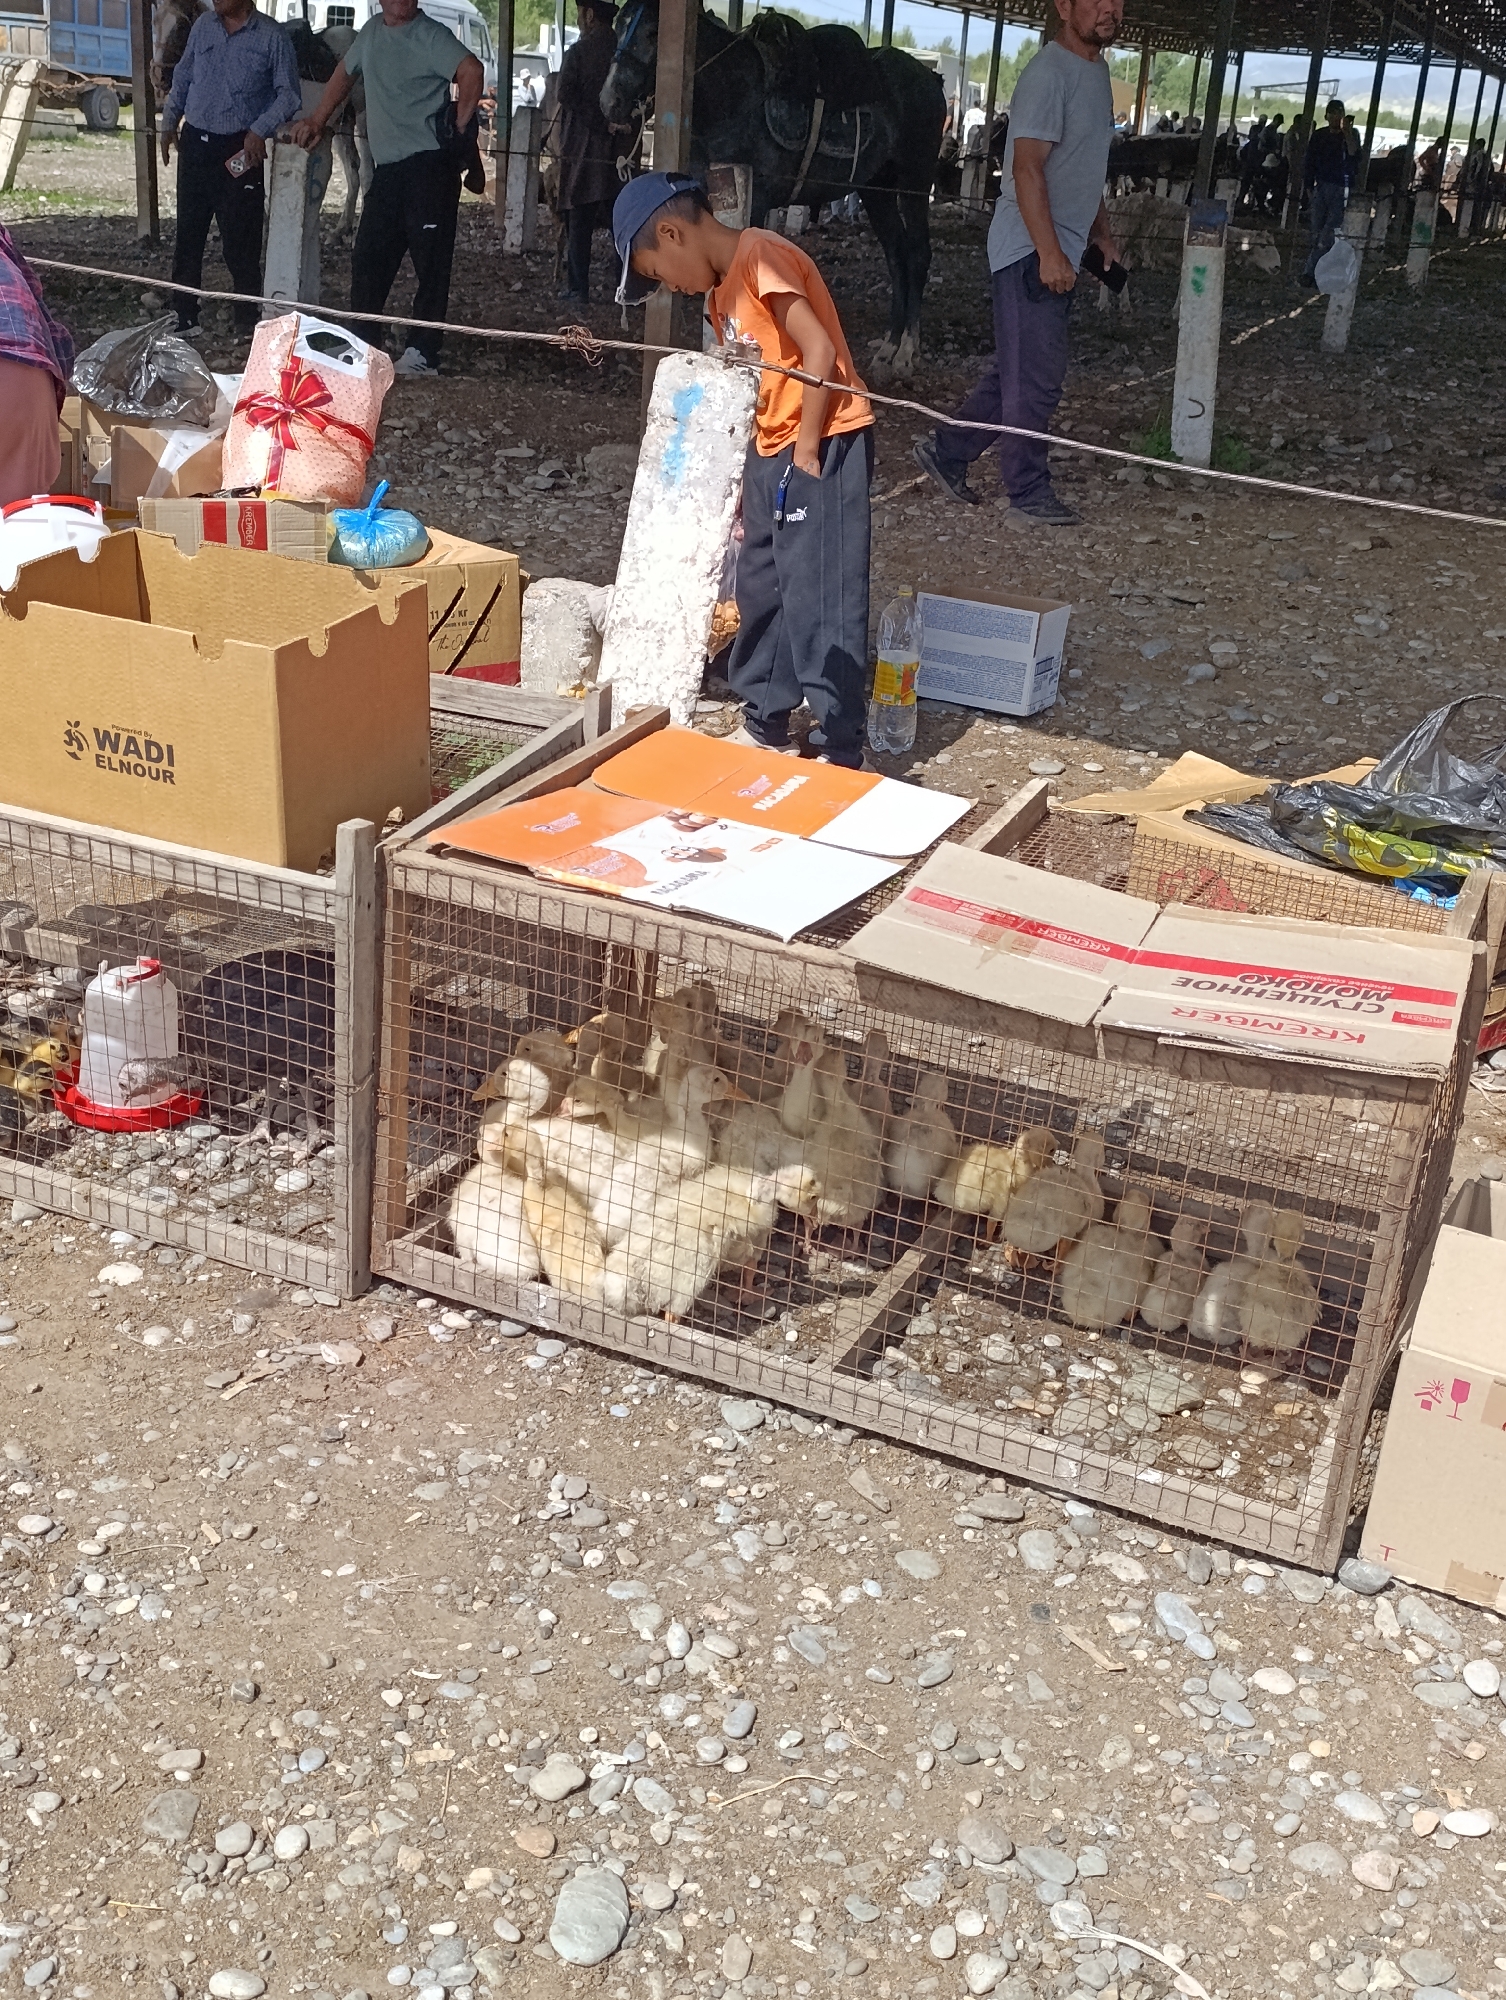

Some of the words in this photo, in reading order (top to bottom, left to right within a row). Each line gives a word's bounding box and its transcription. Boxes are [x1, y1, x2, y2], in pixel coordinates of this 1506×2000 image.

[245, 506, 254, 546] KREMBER
[92, 727, 175, 768] WADI
[111, 724, 142, 736] Powered
[143, 730, 153, 739] By
[95, 753, 176, 785] ELNOUR
[1037, 926, 1111, 953] KREMBER
[1171, 977, 1386, 1014] СГУЩЕННОЕ
[1238, 973, 1392, 1003] МОЛОКО
[1348, 980, 1395, 991] печенье
[1171, 1006, 1366, 1045] KREMBER
